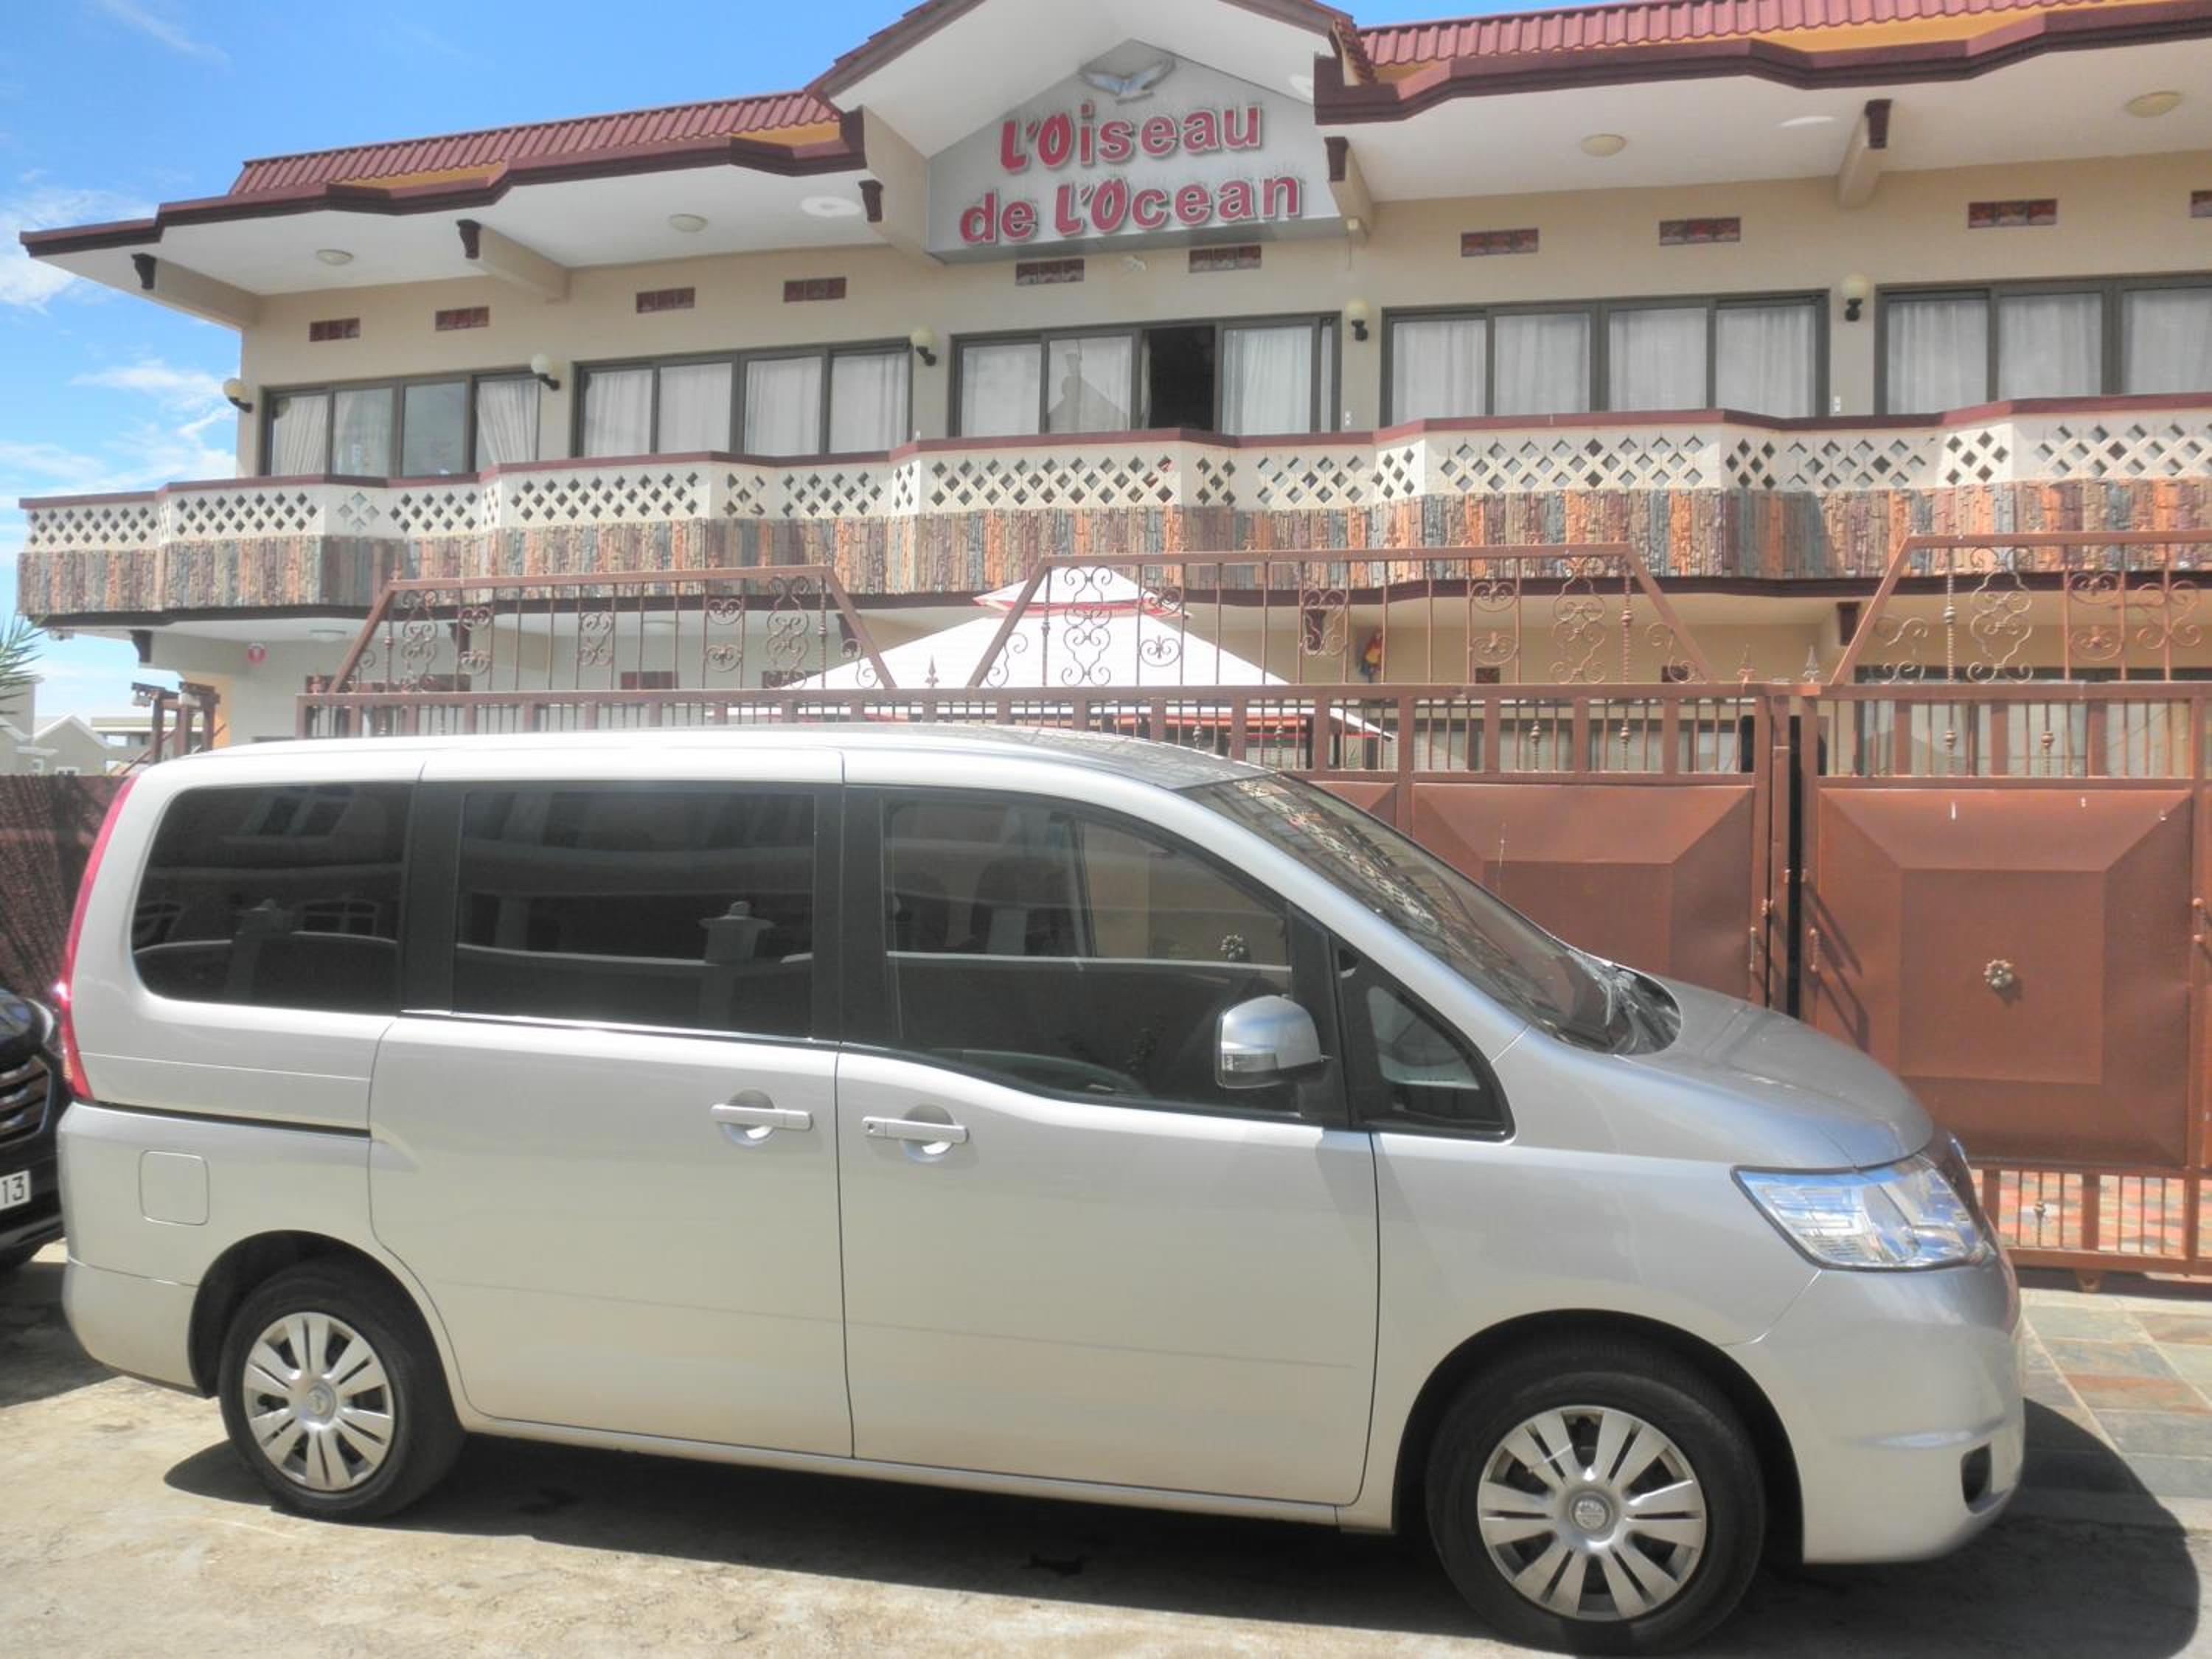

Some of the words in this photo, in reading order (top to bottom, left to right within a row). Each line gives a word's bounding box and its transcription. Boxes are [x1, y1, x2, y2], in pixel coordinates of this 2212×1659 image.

[1000, 100, 1261, 173] L'Oiseau
[960, 189, 1037, 243] de
[1054, 175, 1301, 236] L'Ocean
